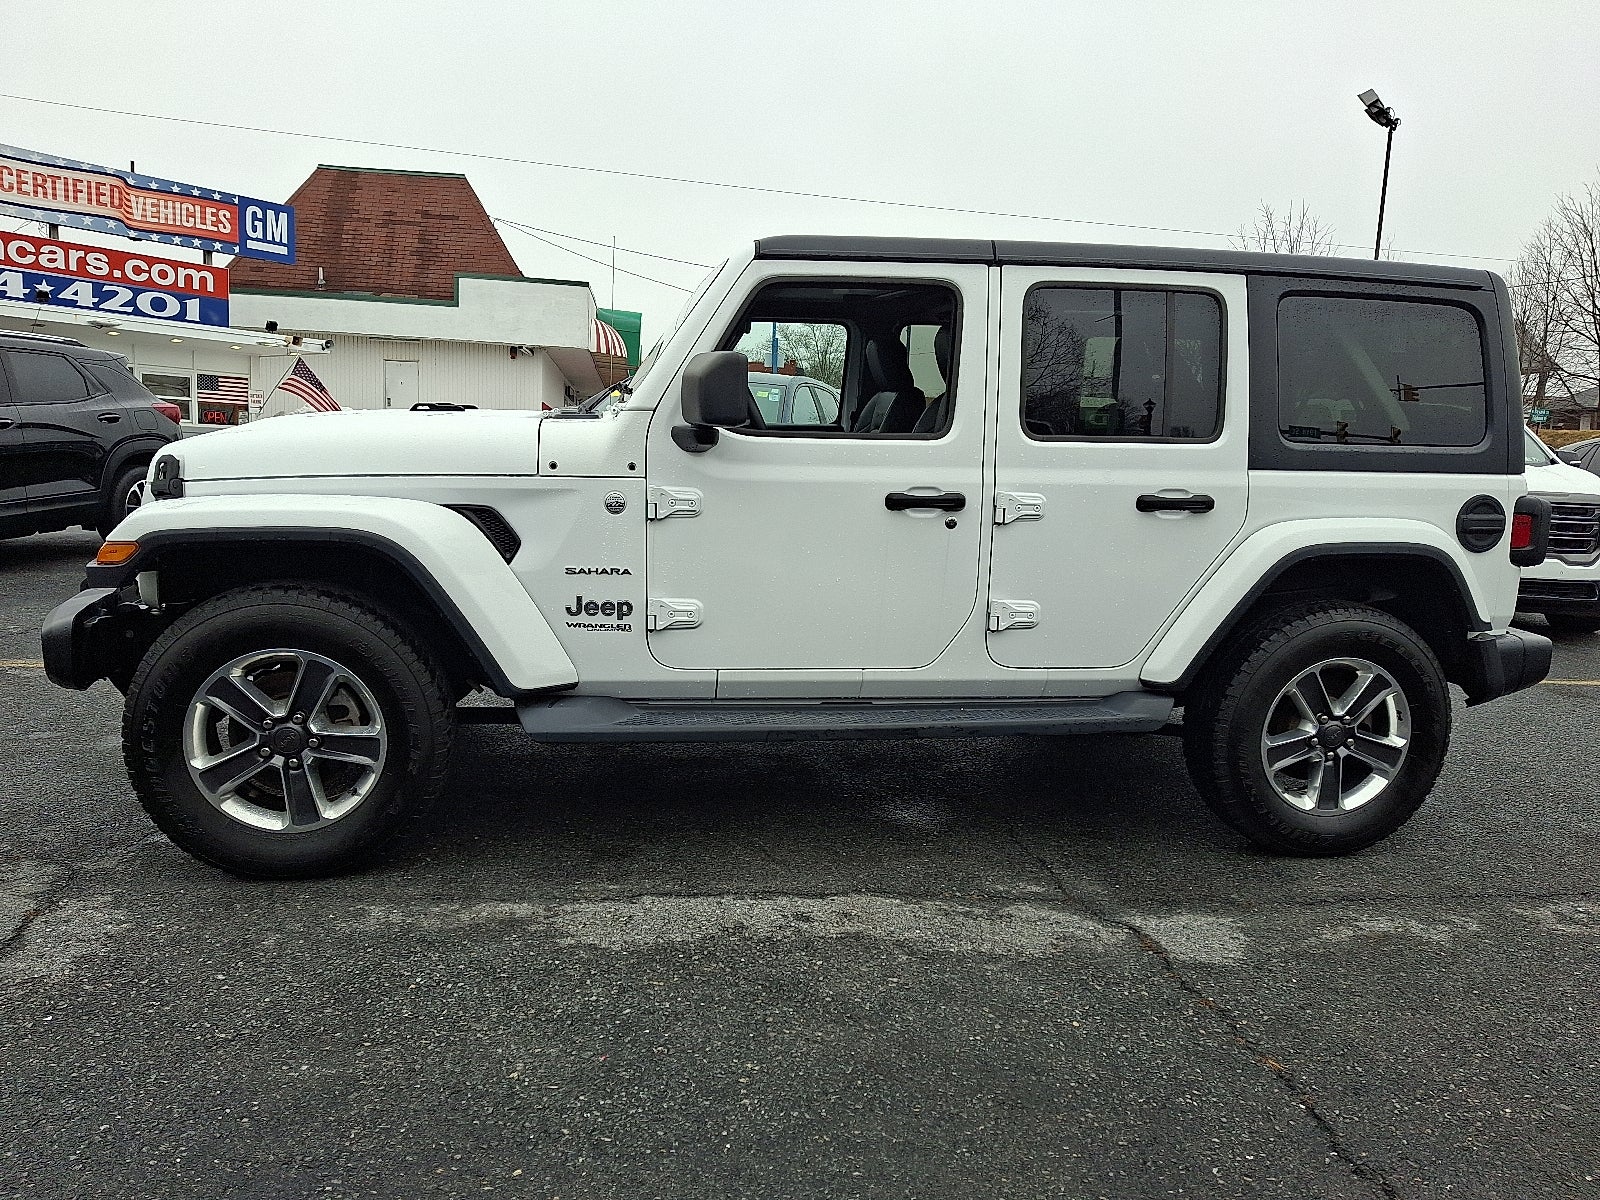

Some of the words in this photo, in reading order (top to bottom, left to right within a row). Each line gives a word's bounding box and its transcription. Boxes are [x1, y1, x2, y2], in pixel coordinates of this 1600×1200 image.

[0, 165, 124, 210] CERTIFIED
[129, 193, 232, 234] VEHICLES
[245, 205, 289, 245] GM
[0, 237, 215, 293] cars.com
[202, 409, 229, 424] OPEN
[564, 567, 633, 576] SAHARA
[565, 594, 634, 621] Jeep
[565, 621, 632, 630] WRANGLER
